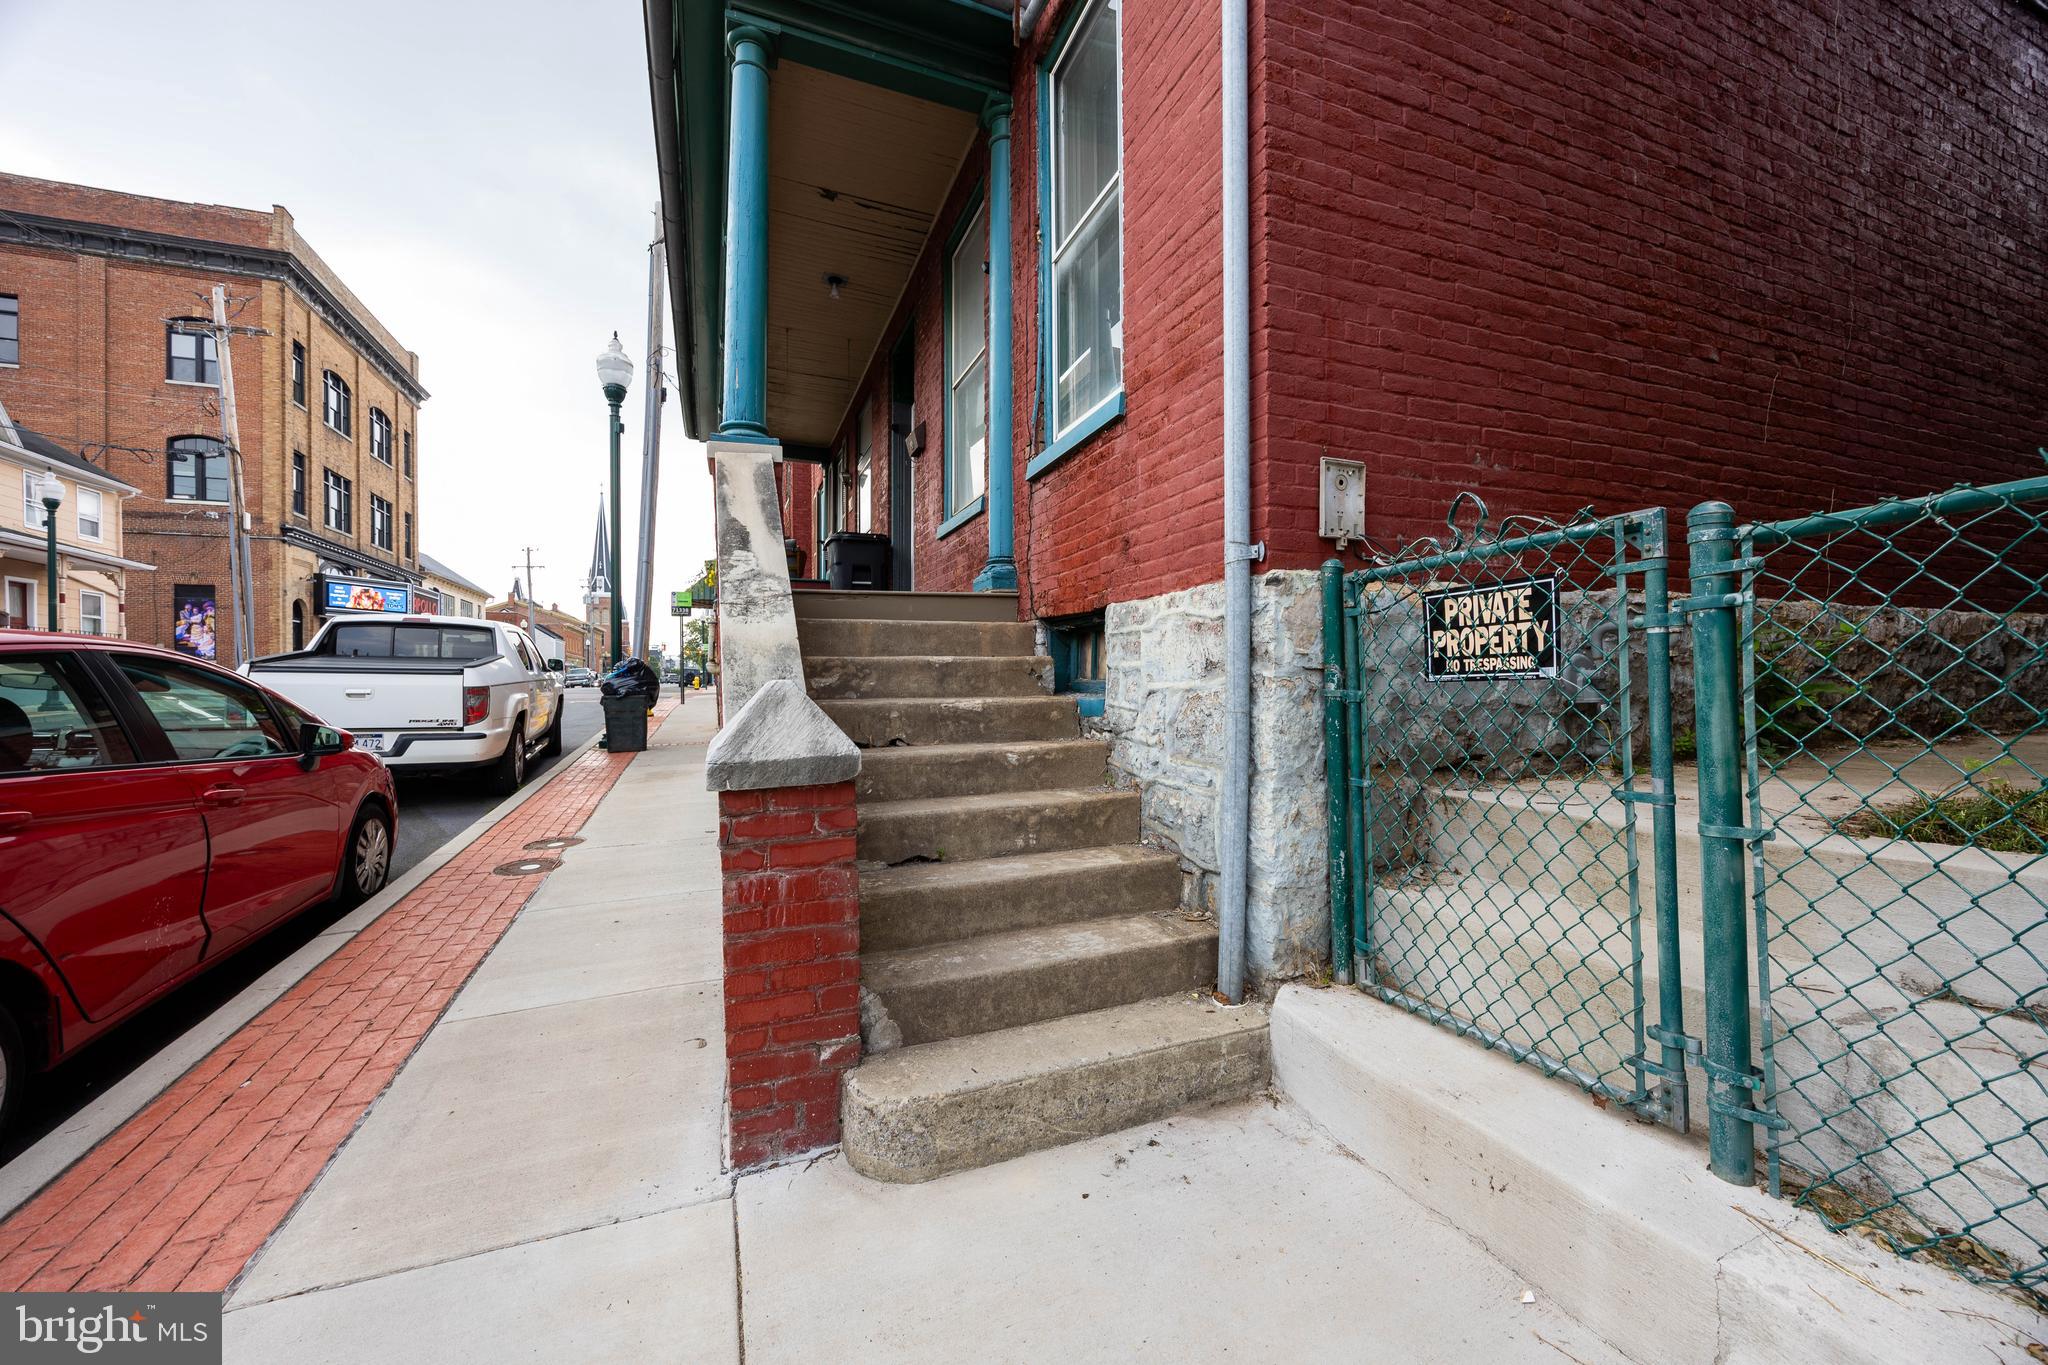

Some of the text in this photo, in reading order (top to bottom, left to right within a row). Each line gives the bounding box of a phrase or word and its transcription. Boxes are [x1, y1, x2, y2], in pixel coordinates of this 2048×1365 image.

[1444, 587, 1533, 627] PRIVATE
[1433, 620, 1549, 658] PROPERTY
[1463, 655, 1536, 671] TRESPASSING
[362, 739, 381, 748] 472
